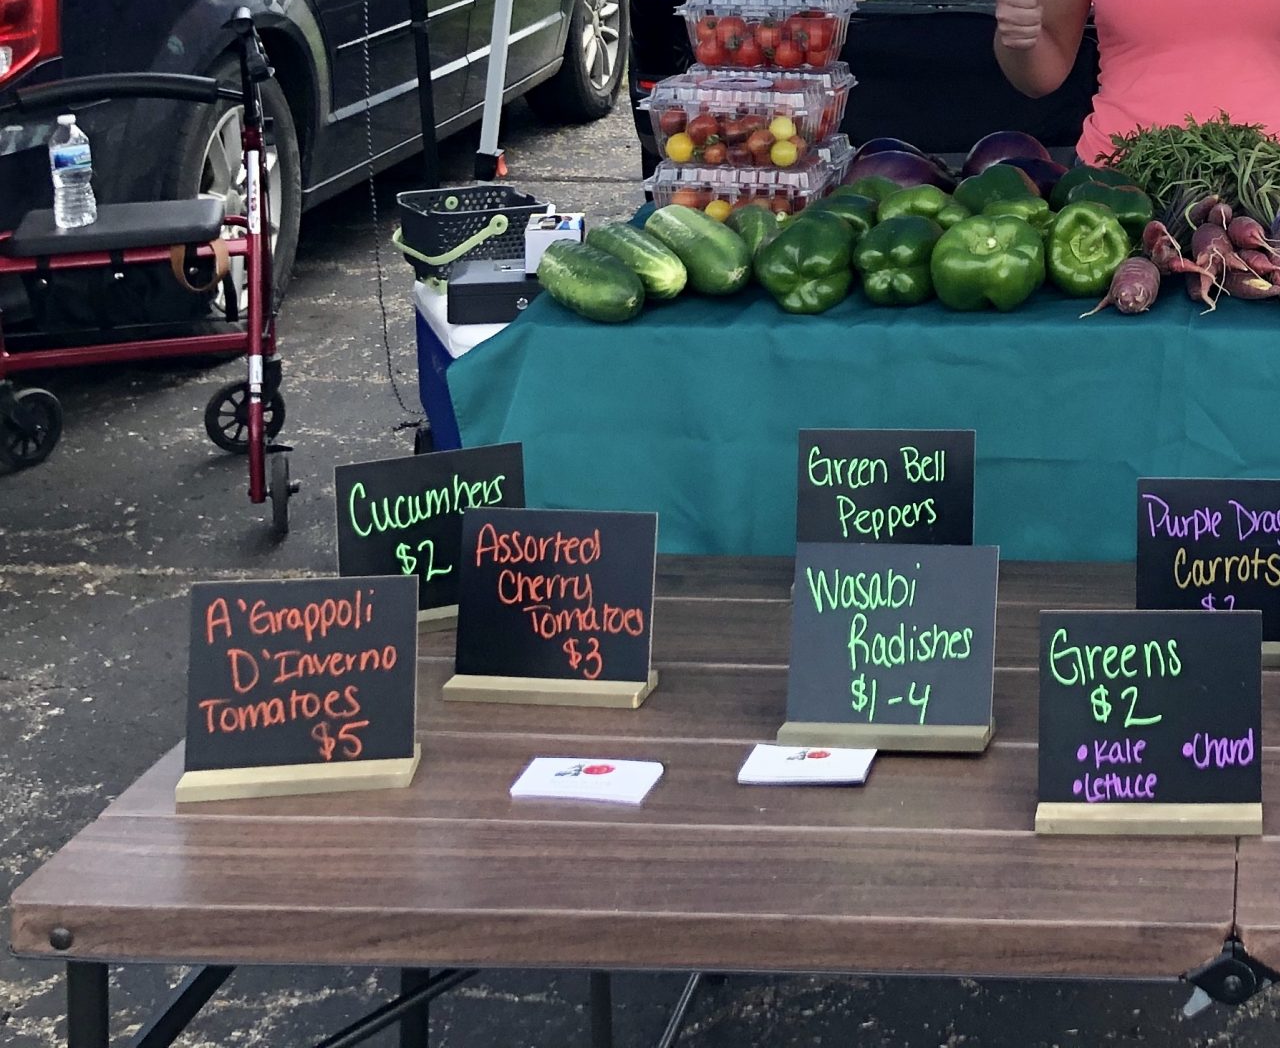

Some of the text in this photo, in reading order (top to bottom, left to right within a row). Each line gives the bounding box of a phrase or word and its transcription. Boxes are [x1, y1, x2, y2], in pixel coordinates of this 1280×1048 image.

[808, 445, 946, 489] Green Bell
[349, 473, 506, 537] Cucumbers
[836, 495, 937, 540] Peppers
[1142, 493, 1221, 541] Purple
[396, 539, 452, 581] $2
[476, 523, 601, 567] Assorted
[498, 569, 593, 607] Cherry
[805, 562, 921, 613] Wasabi
[523, 604, 644, 639] Tomatoes
[848, 612, 973, 670] Radishes
[562, 637, 603, 680] $3
[1050, 628, 1183, 686] Greens
[199, 685, 361, 734] Tomatoes
[1090, 684, 1162, 728] $2
[311, 720, 369, 760] $5
[1093, 727, 1255, 771] Kale Chard
[1083, 772, 1158, 803] Lettuce
